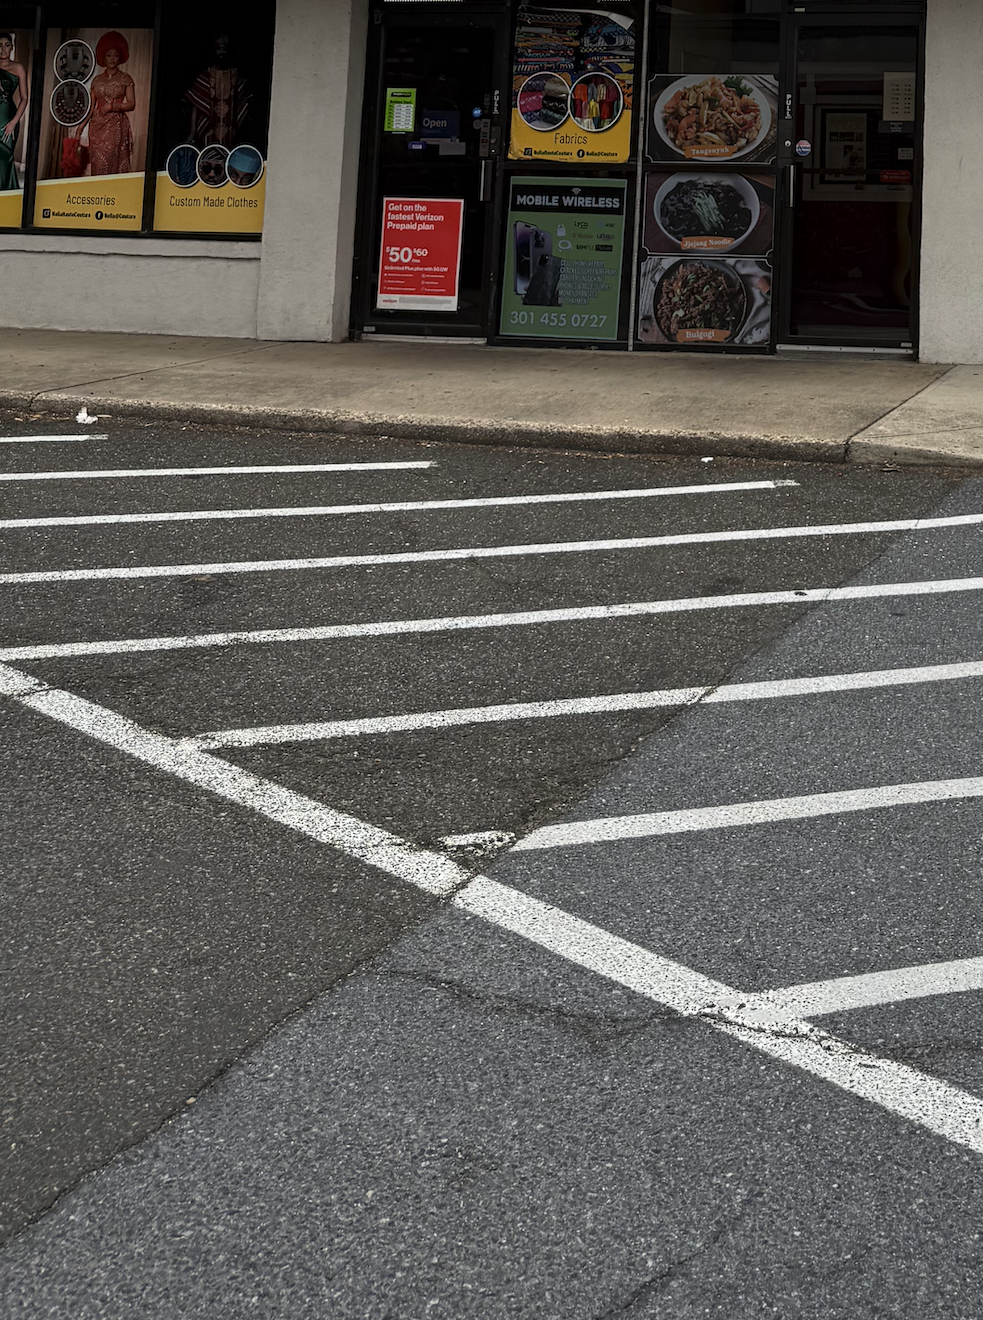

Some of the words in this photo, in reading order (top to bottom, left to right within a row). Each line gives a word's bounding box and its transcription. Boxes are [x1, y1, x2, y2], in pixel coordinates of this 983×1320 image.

[784, 93, 793, 120] PULL
[422, 117, 448, 129] Open
[554, 133, 588, 145] Fabrics
[66, 194, 116, 207] Accessories
[170, 196, 201, 207] Custom
[203, 197, 225, 207] Made
[227, 197, 259, 208] Clothes
[516, 194, 560, 207] MOBILE
[562, 195, 620, 209] WIRELESS
[388, 203, 402, 212] Get
[414, 204, 427, 212] the
[387, 212, 415, 221] fastest
[415, 213, 444, 221] Verizon
[386, 221, 417, 231] Prepaid
[417, 223, 435, 231] plan
[709, 238, 731, 246] Noodle
[510, 311, 535, 325] 301
[540, 312, 567, 327] 455
[570, 313, 608, 328] 0727
[686, 330, 715, 340] Bulgogi
